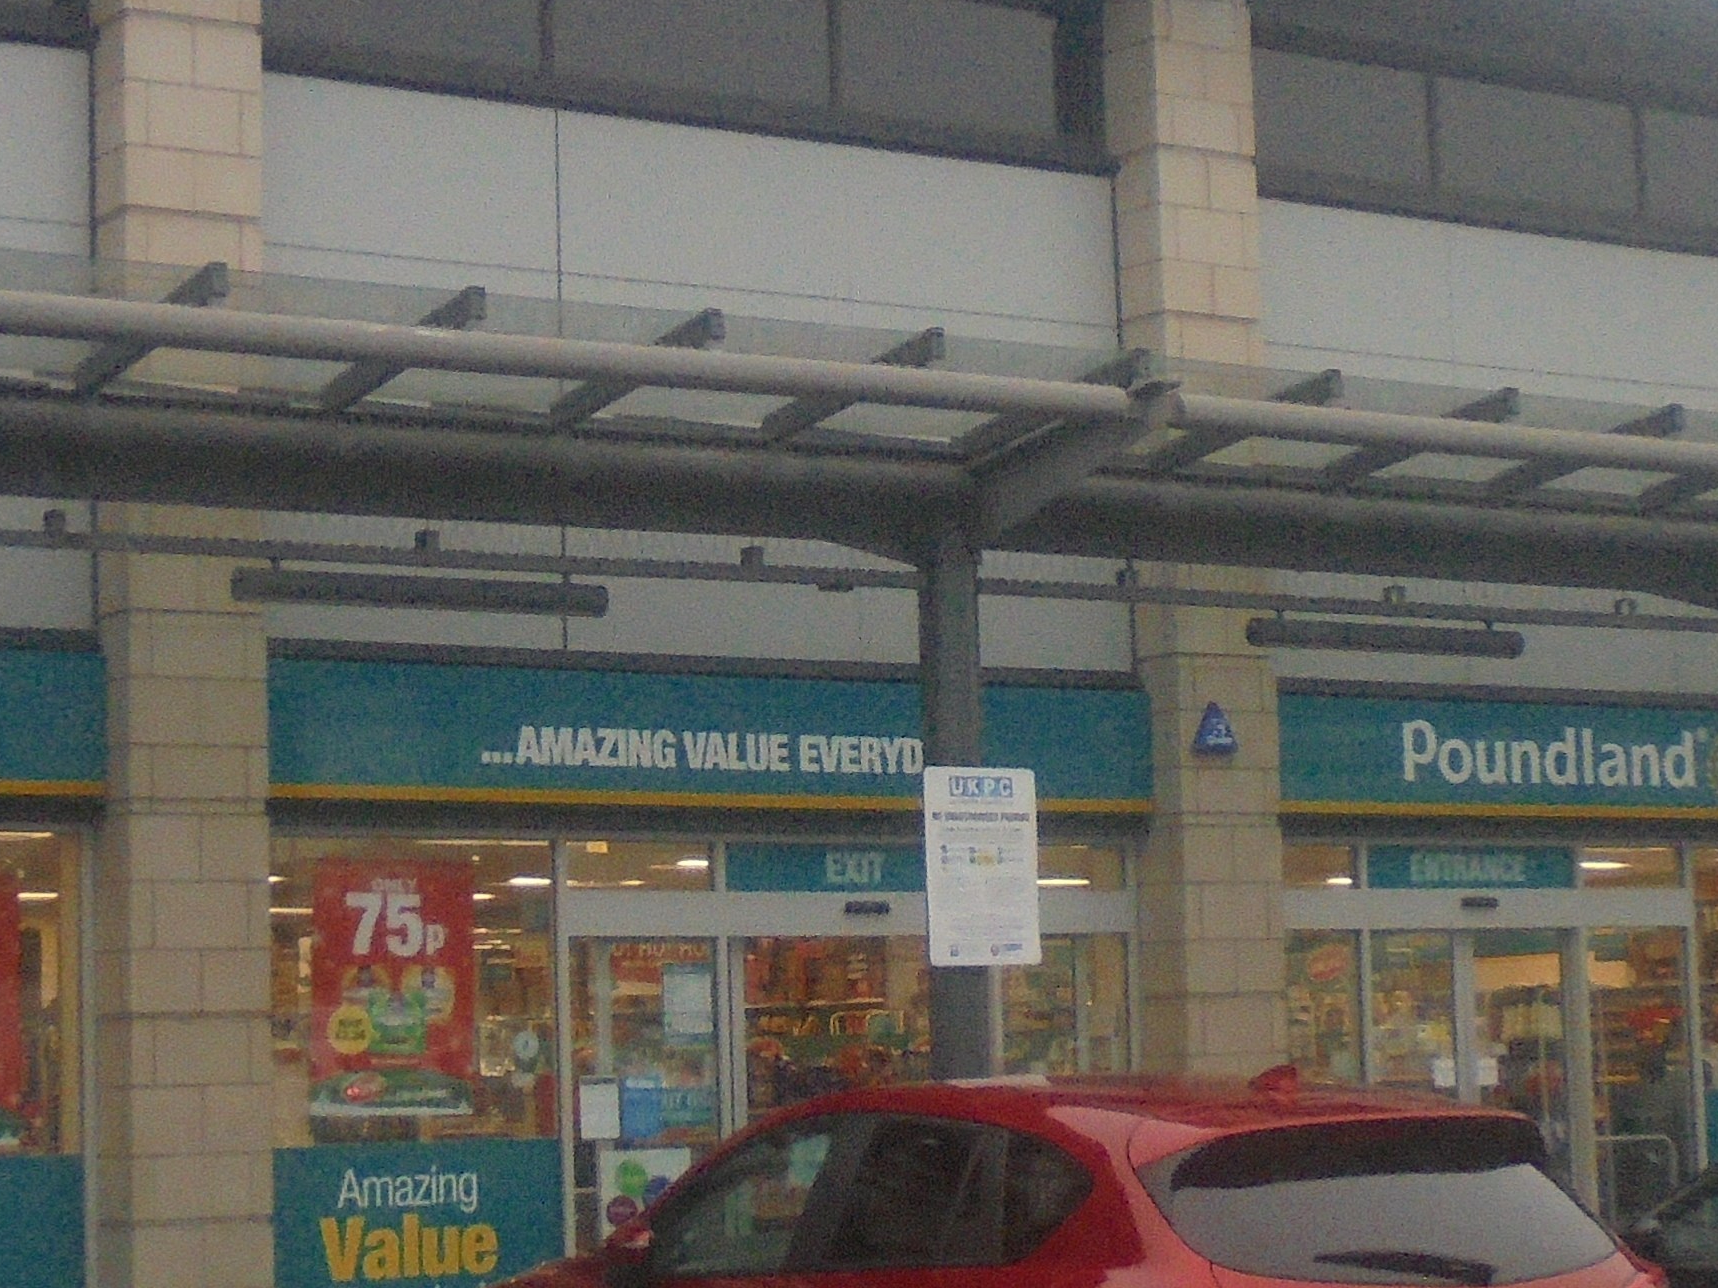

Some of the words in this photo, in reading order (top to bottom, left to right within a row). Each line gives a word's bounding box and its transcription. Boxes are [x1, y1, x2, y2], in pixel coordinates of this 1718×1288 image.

[683, 731, 791, 772] VALUE
[798, 734, 925, 775] EVERYD
[1402, 719, 1698, 789] Poundland
[824, 851, 883, 885] EXIT
[345, 891, 447, 958] 75p
[337, 1165, 479, 1214] Amazing
[320, 1213, 500, 1282] Value
